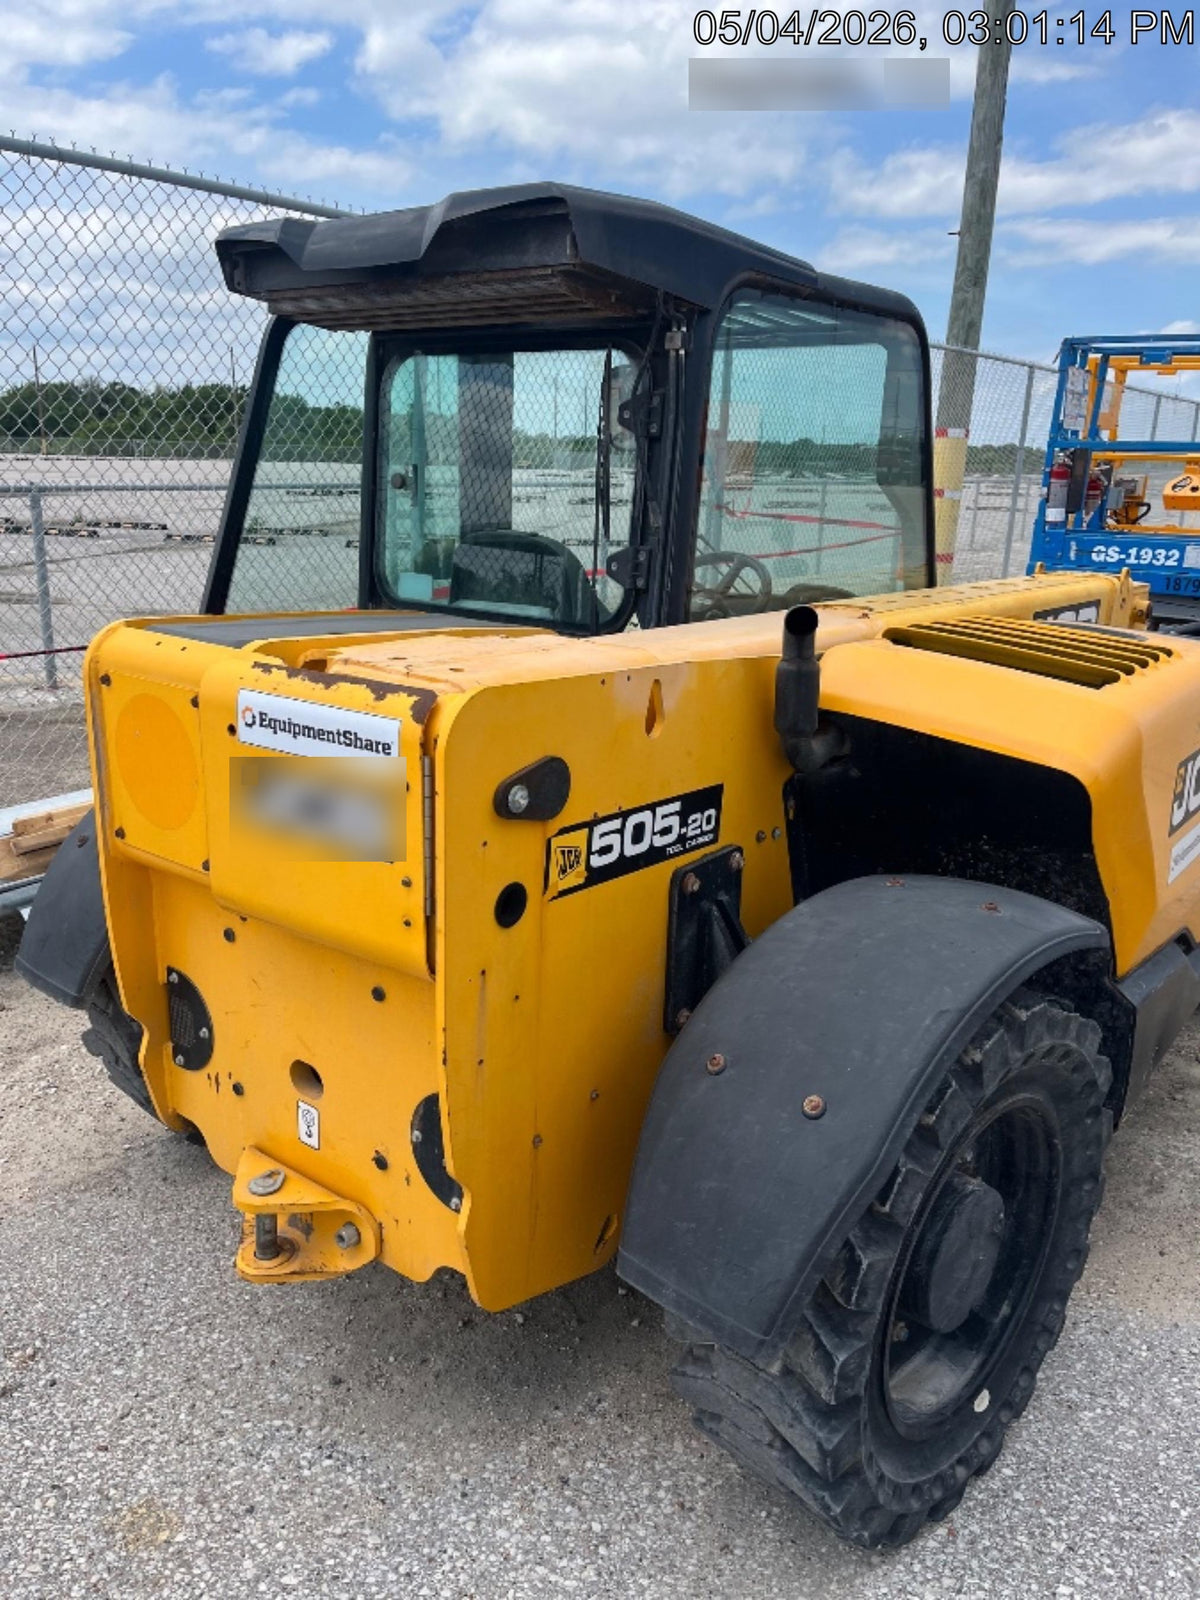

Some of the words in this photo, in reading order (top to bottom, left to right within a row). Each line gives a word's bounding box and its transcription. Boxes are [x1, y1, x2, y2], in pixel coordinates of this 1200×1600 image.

[1091, 545, 1180, 567] GS-1932
[258, 711, 392, 756] EquipmentShare
[589, 801, 717, 868] 505-20
